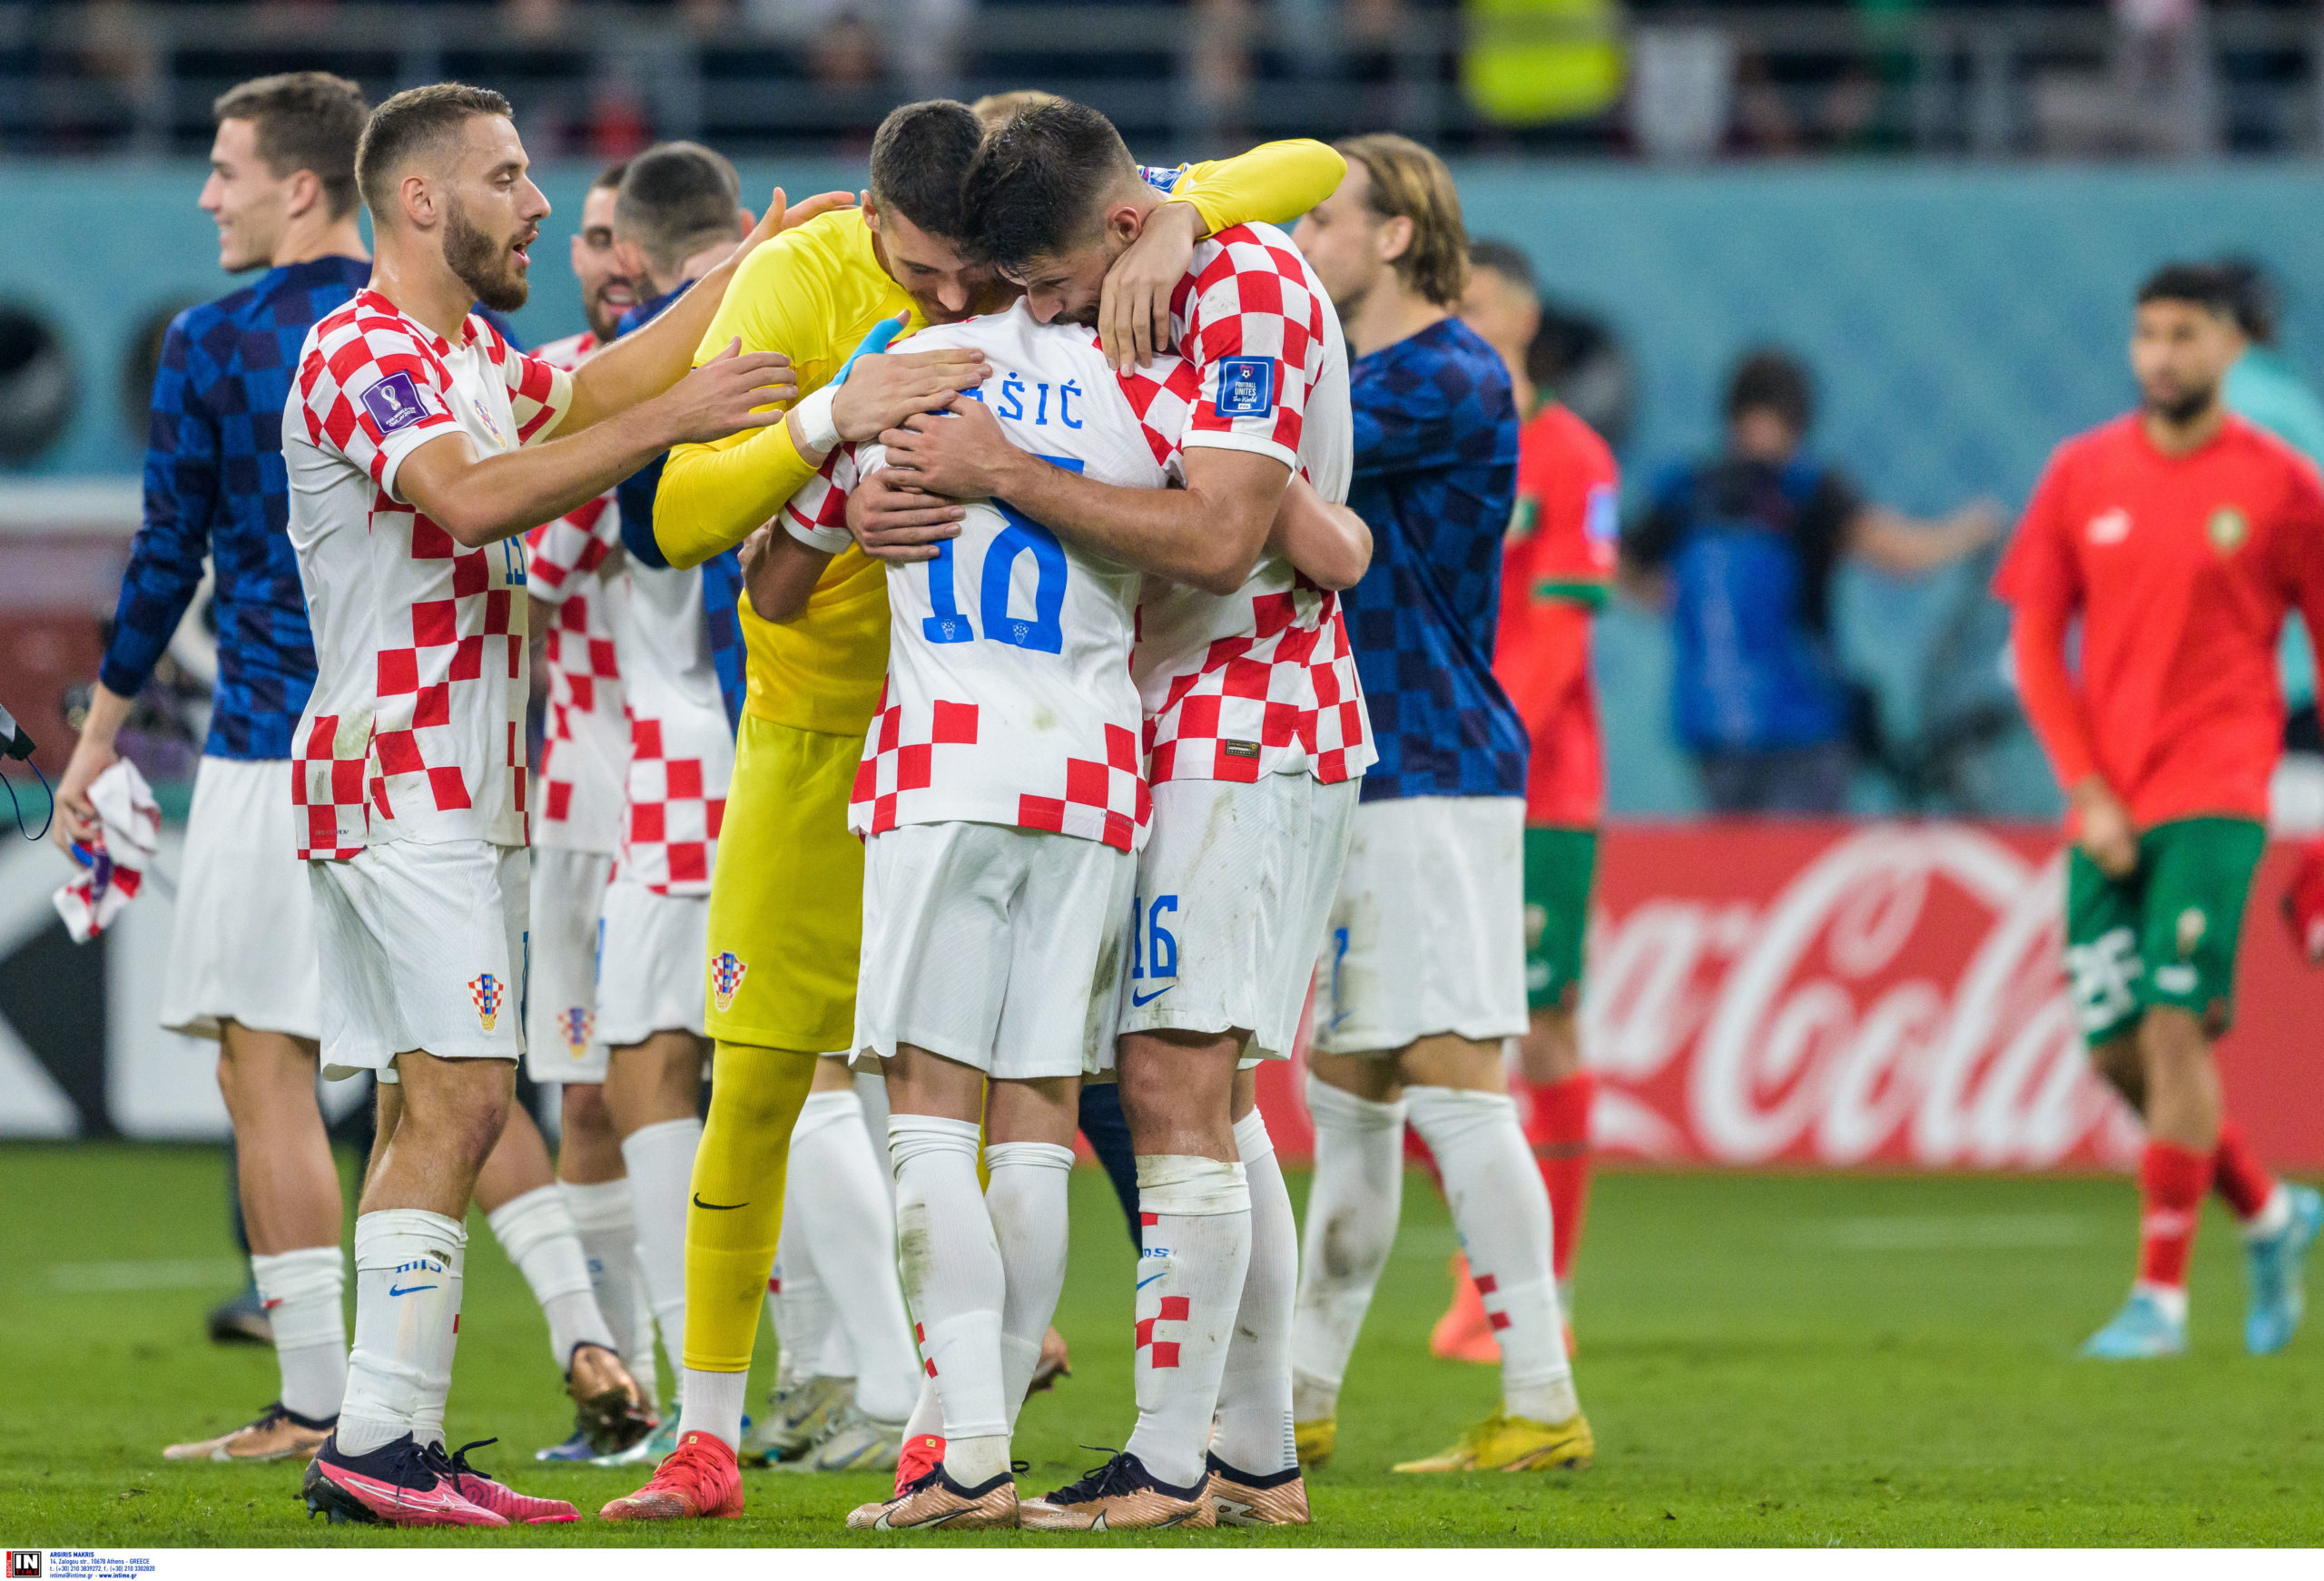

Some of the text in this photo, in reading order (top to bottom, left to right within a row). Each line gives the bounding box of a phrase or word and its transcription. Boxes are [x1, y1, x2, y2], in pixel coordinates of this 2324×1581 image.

[960, 370, 1083, 429] ŠIĆ
[1235, 388, 1256, 396] UNITES
[1132, 894, 1178, 979] 16
